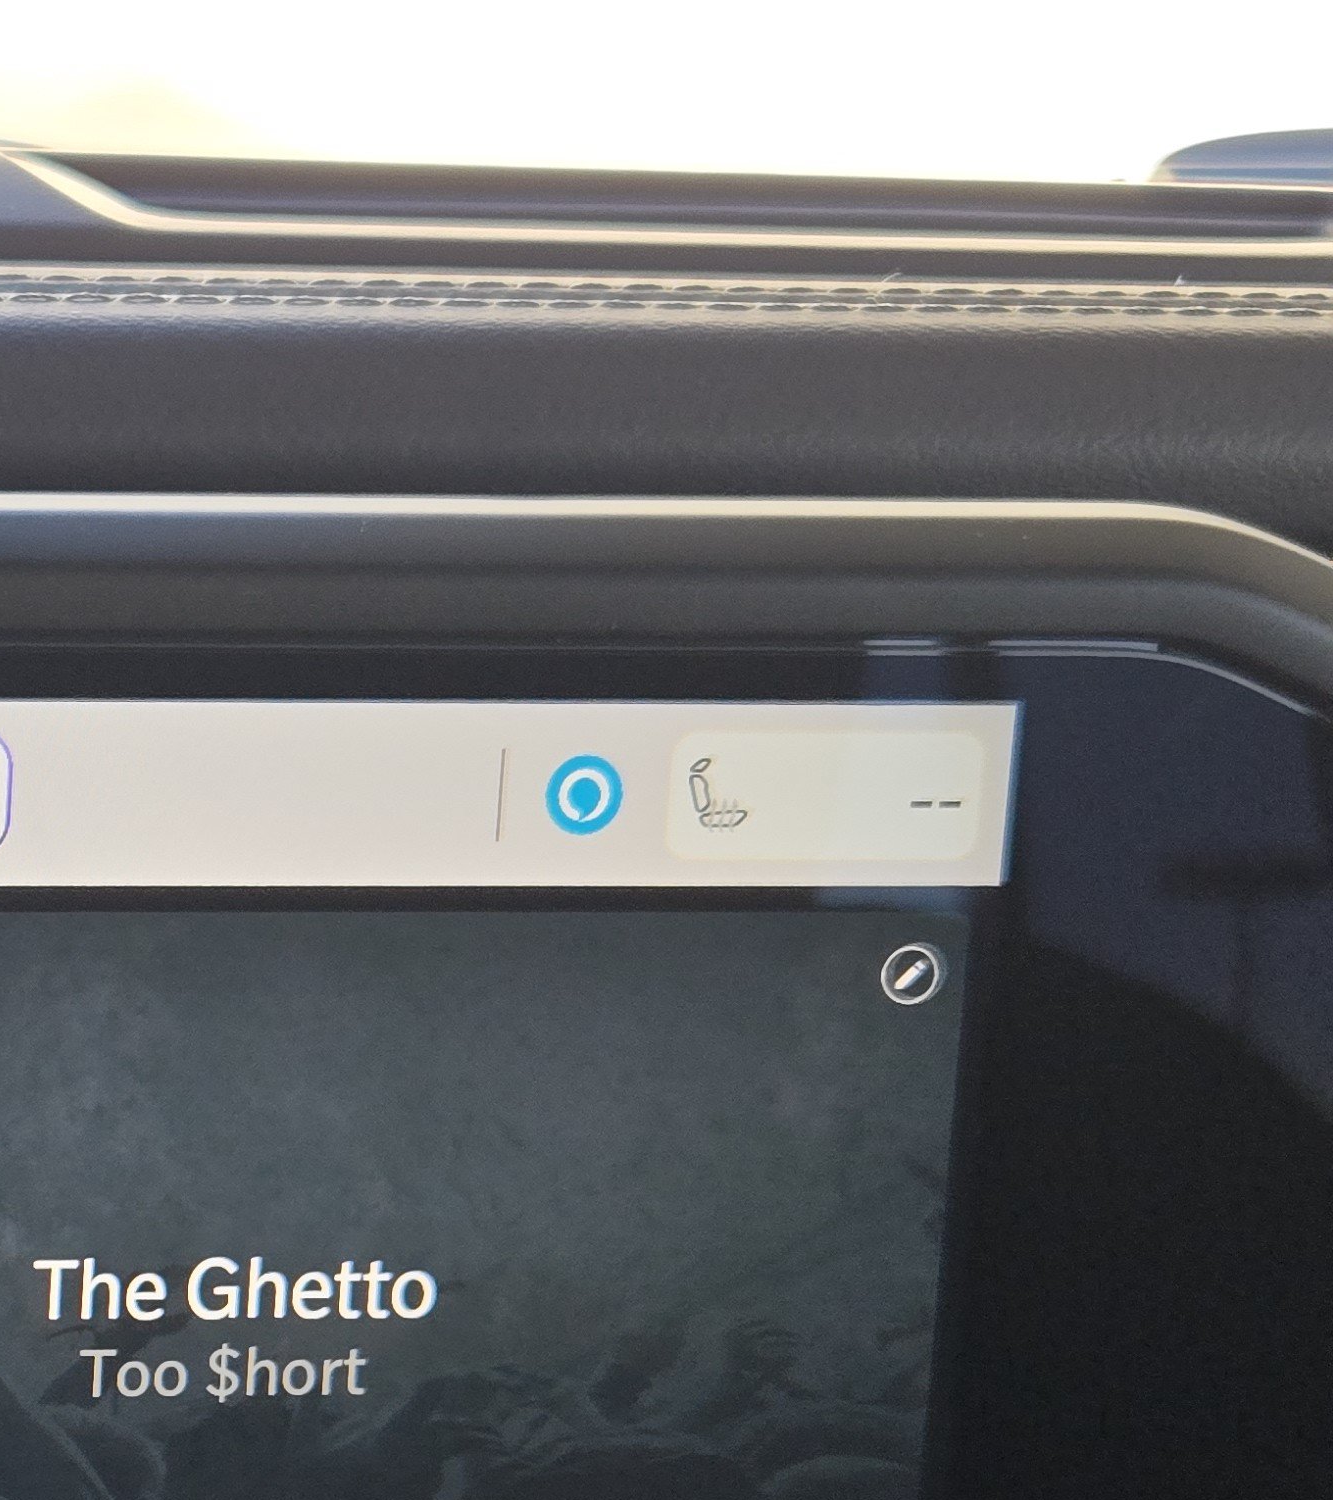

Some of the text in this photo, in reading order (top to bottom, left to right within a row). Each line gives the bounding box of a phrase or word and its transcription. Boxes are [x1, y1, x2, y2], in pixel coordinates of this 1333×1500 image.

[33, 1255, 439, 1321] The Ghetto
[79, 1342, 368, 1404] Too $hort
